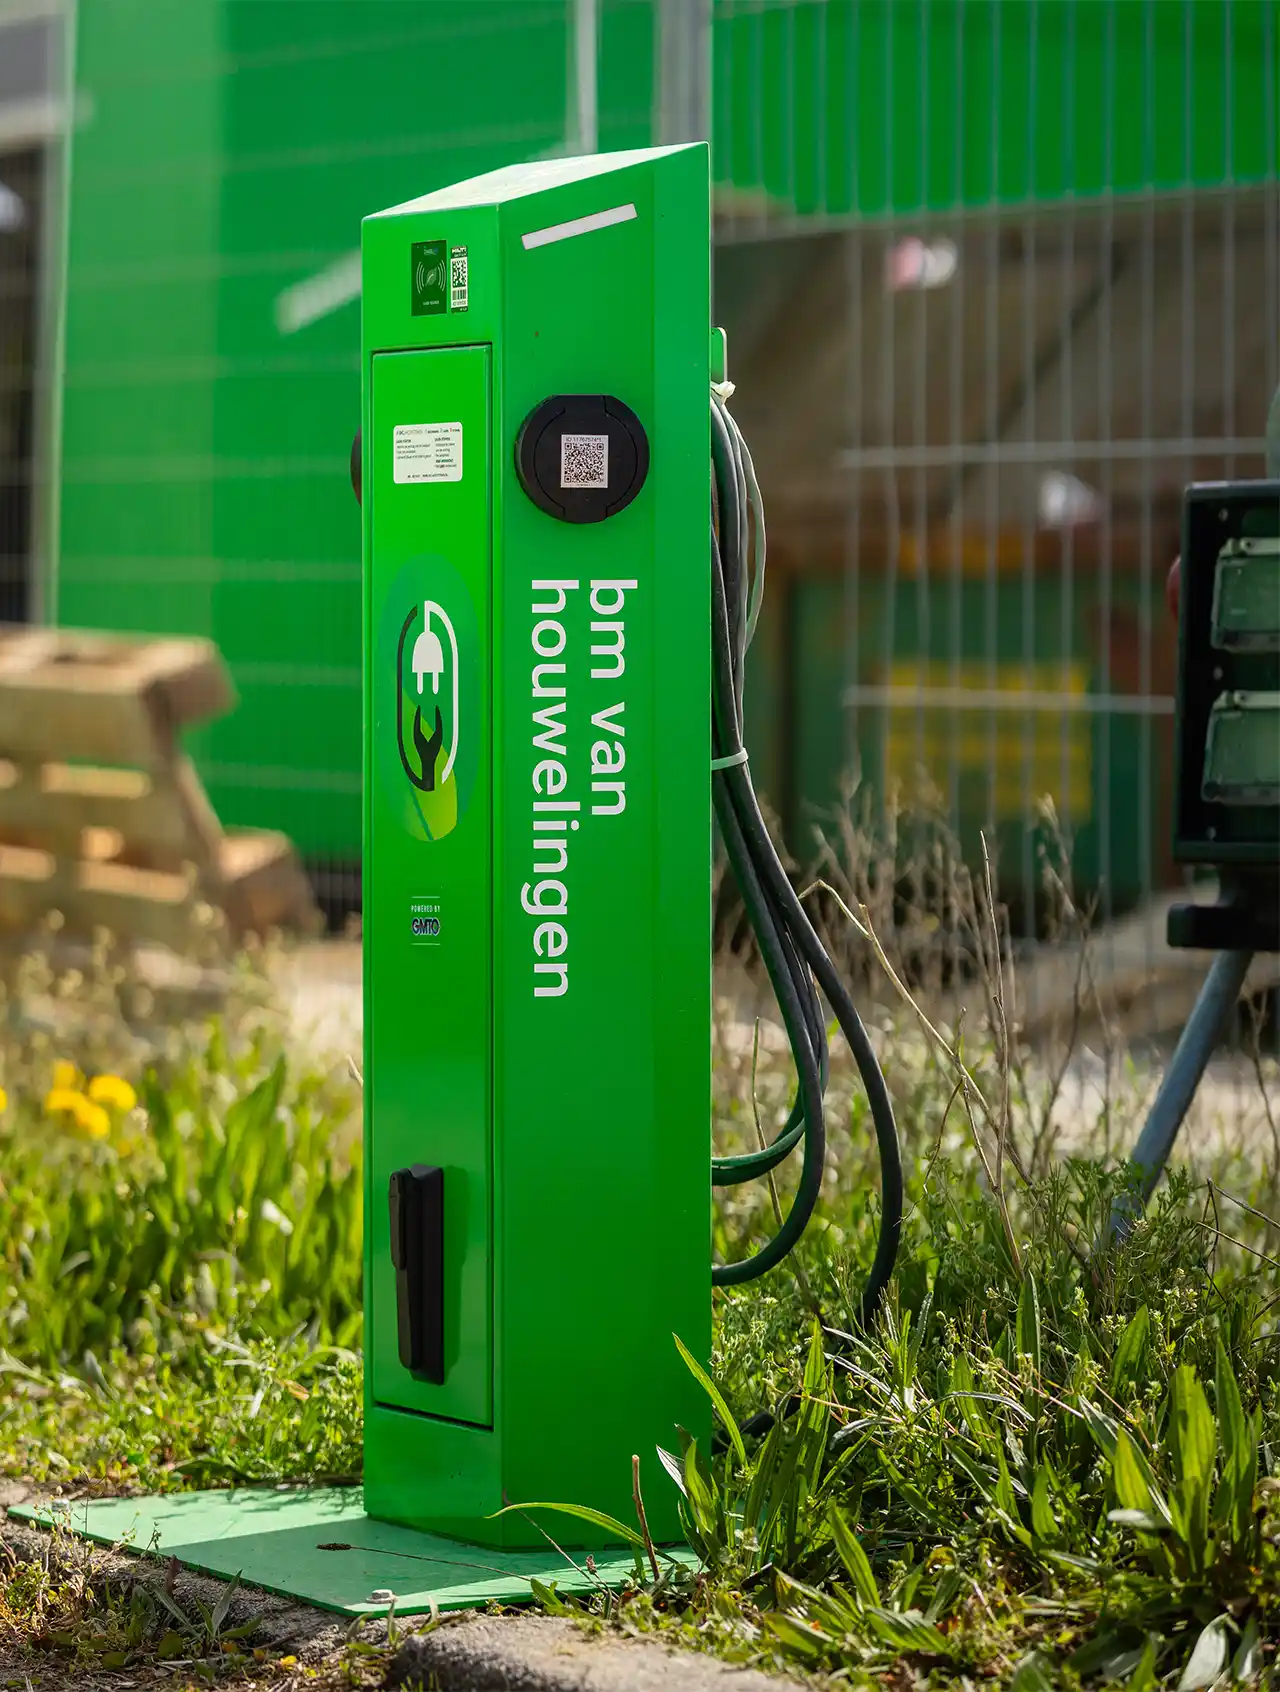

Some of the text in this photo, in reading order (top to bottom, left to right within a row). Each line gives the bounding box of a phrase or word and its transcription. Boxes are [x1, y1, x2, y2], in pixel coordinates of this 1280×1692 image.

[520, 579, 581, 997] houwelingen
[589, 579, 638, 815] bm van
